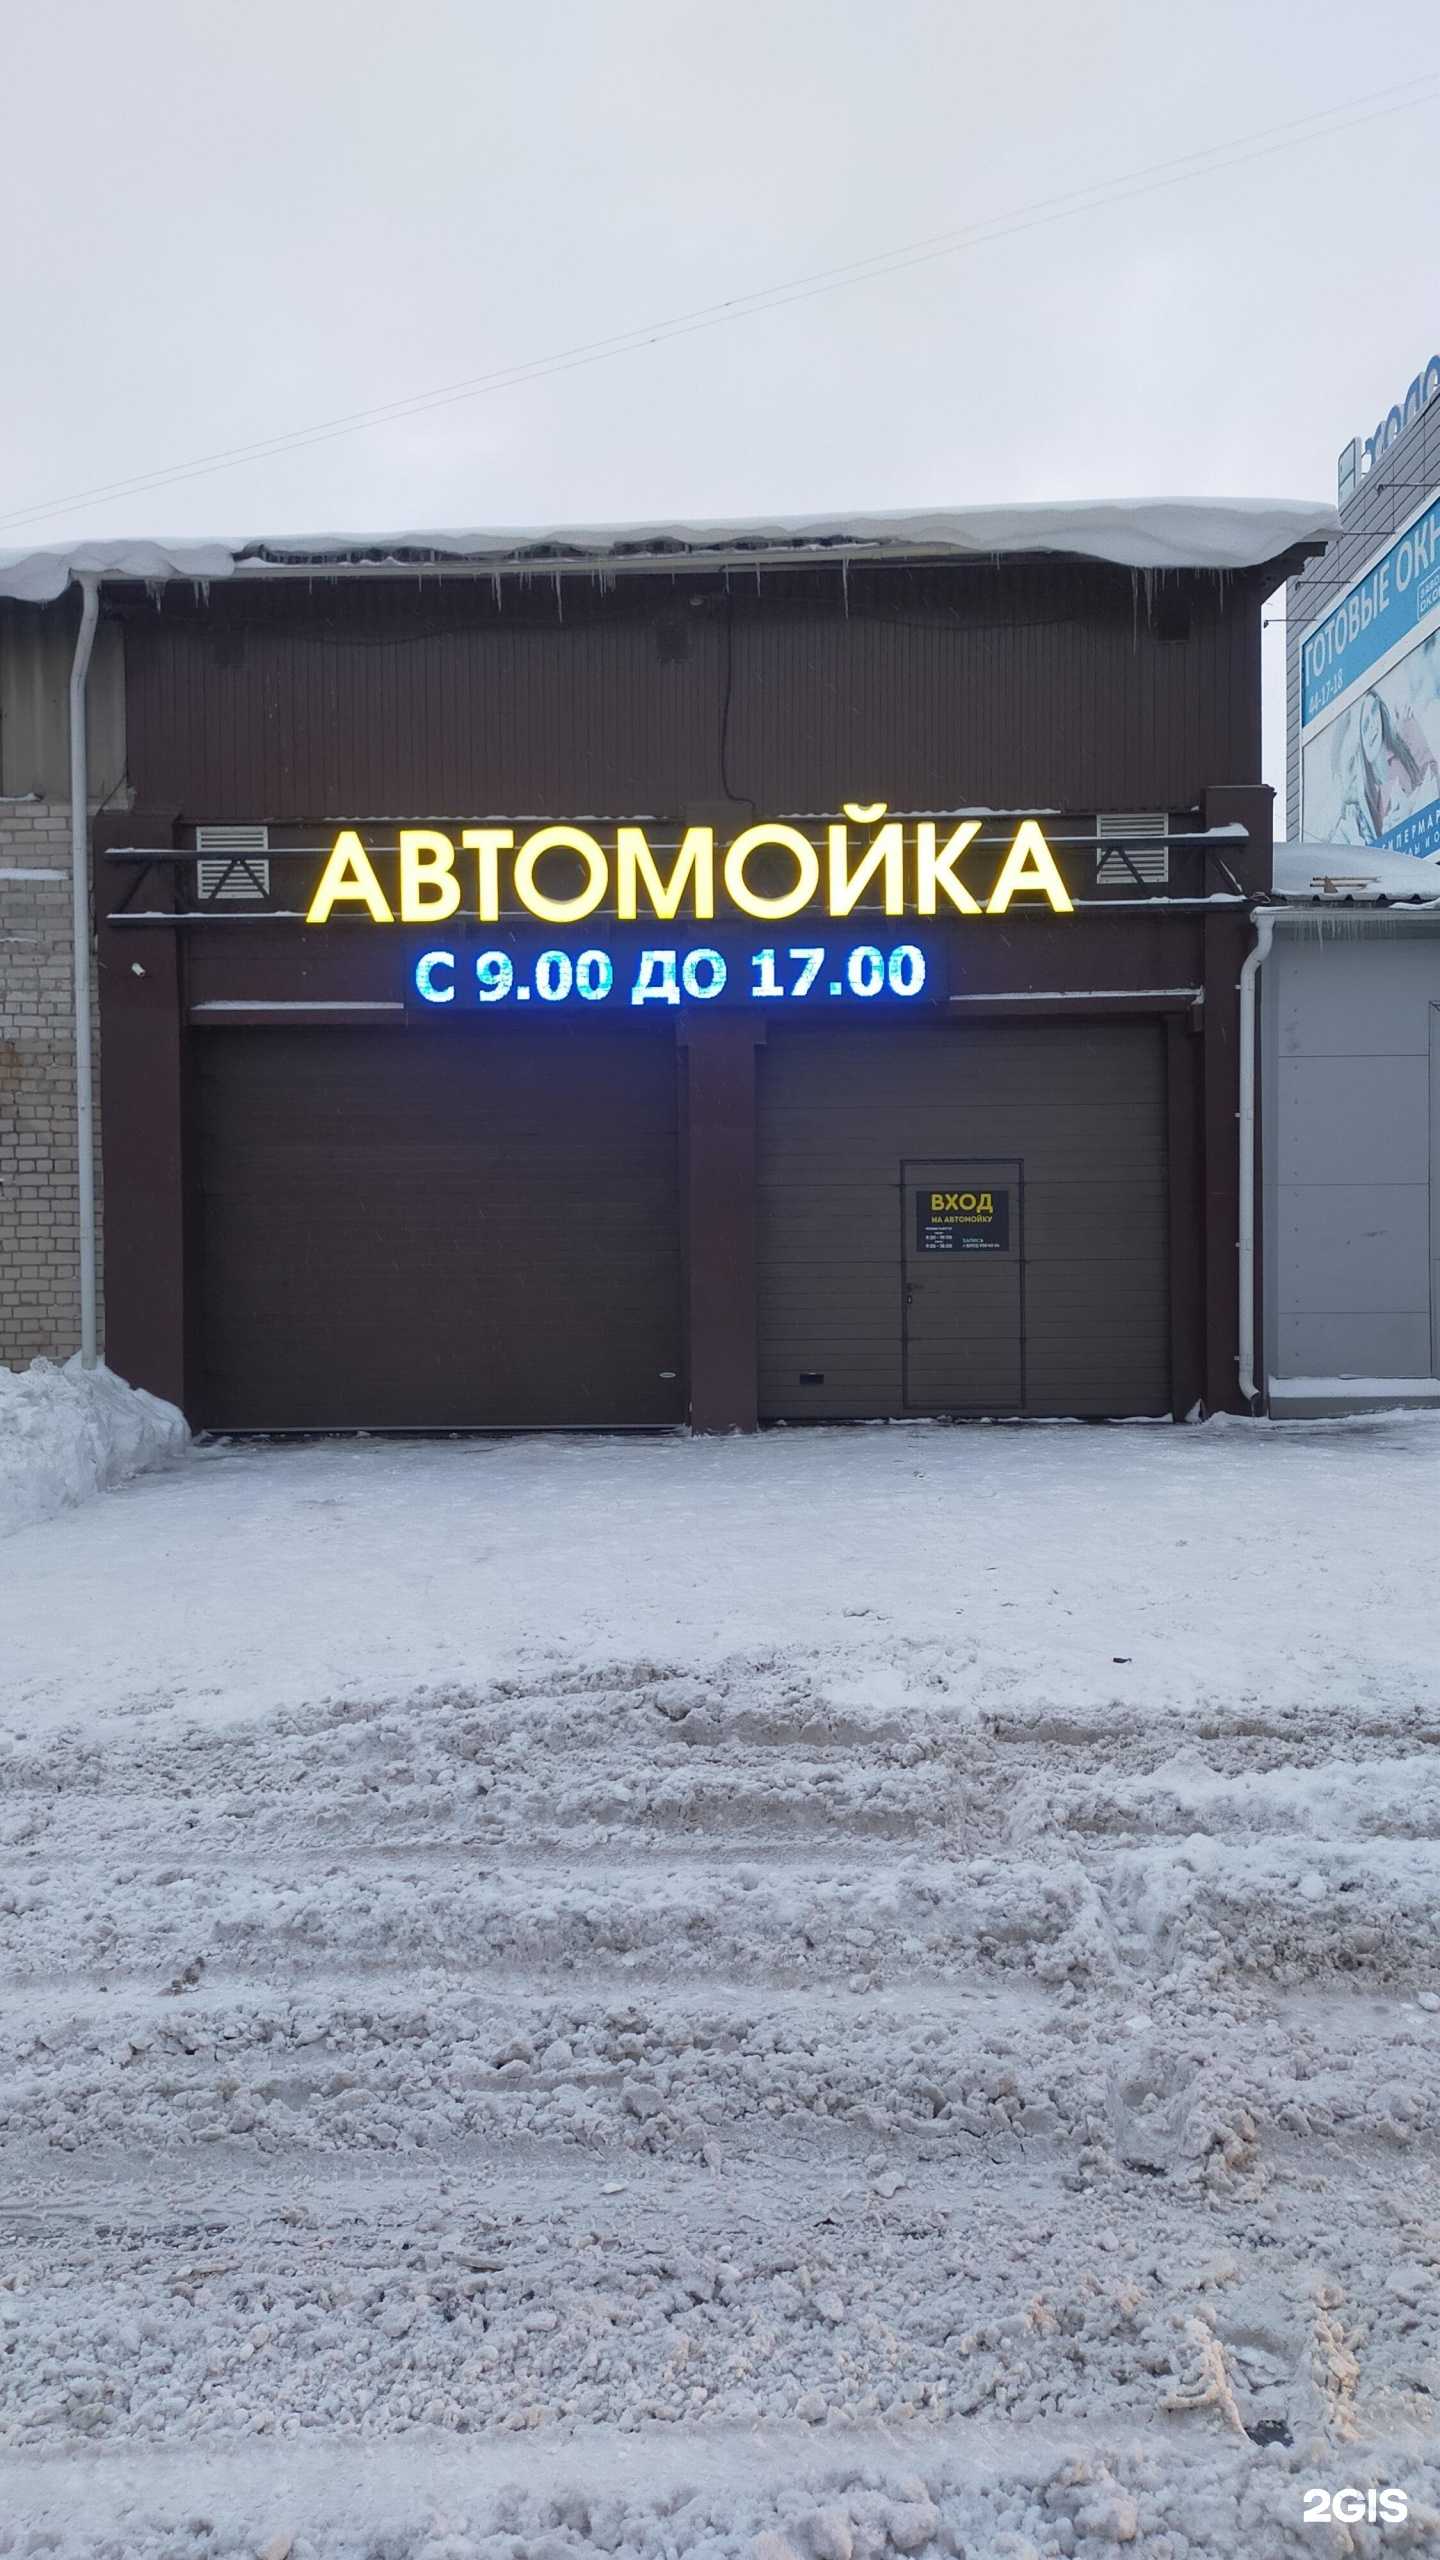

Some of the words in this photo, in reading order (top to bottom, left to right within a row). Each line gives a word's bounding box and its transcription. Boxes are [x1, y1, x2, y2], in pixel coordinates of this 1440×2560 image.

[1304, 560, 1390, 688] ГОТОВЫЕ
[305, 803, 1075, 924] АВТОМОЙКА
[414, 951, 455, 1002] С
[475, 950, 613, 1002] 9.00
[631, 948, 728, 1005] ДО
[751, 944, 926, 998] 17.00
[931, 1193, 993, 1214] ВХОД
